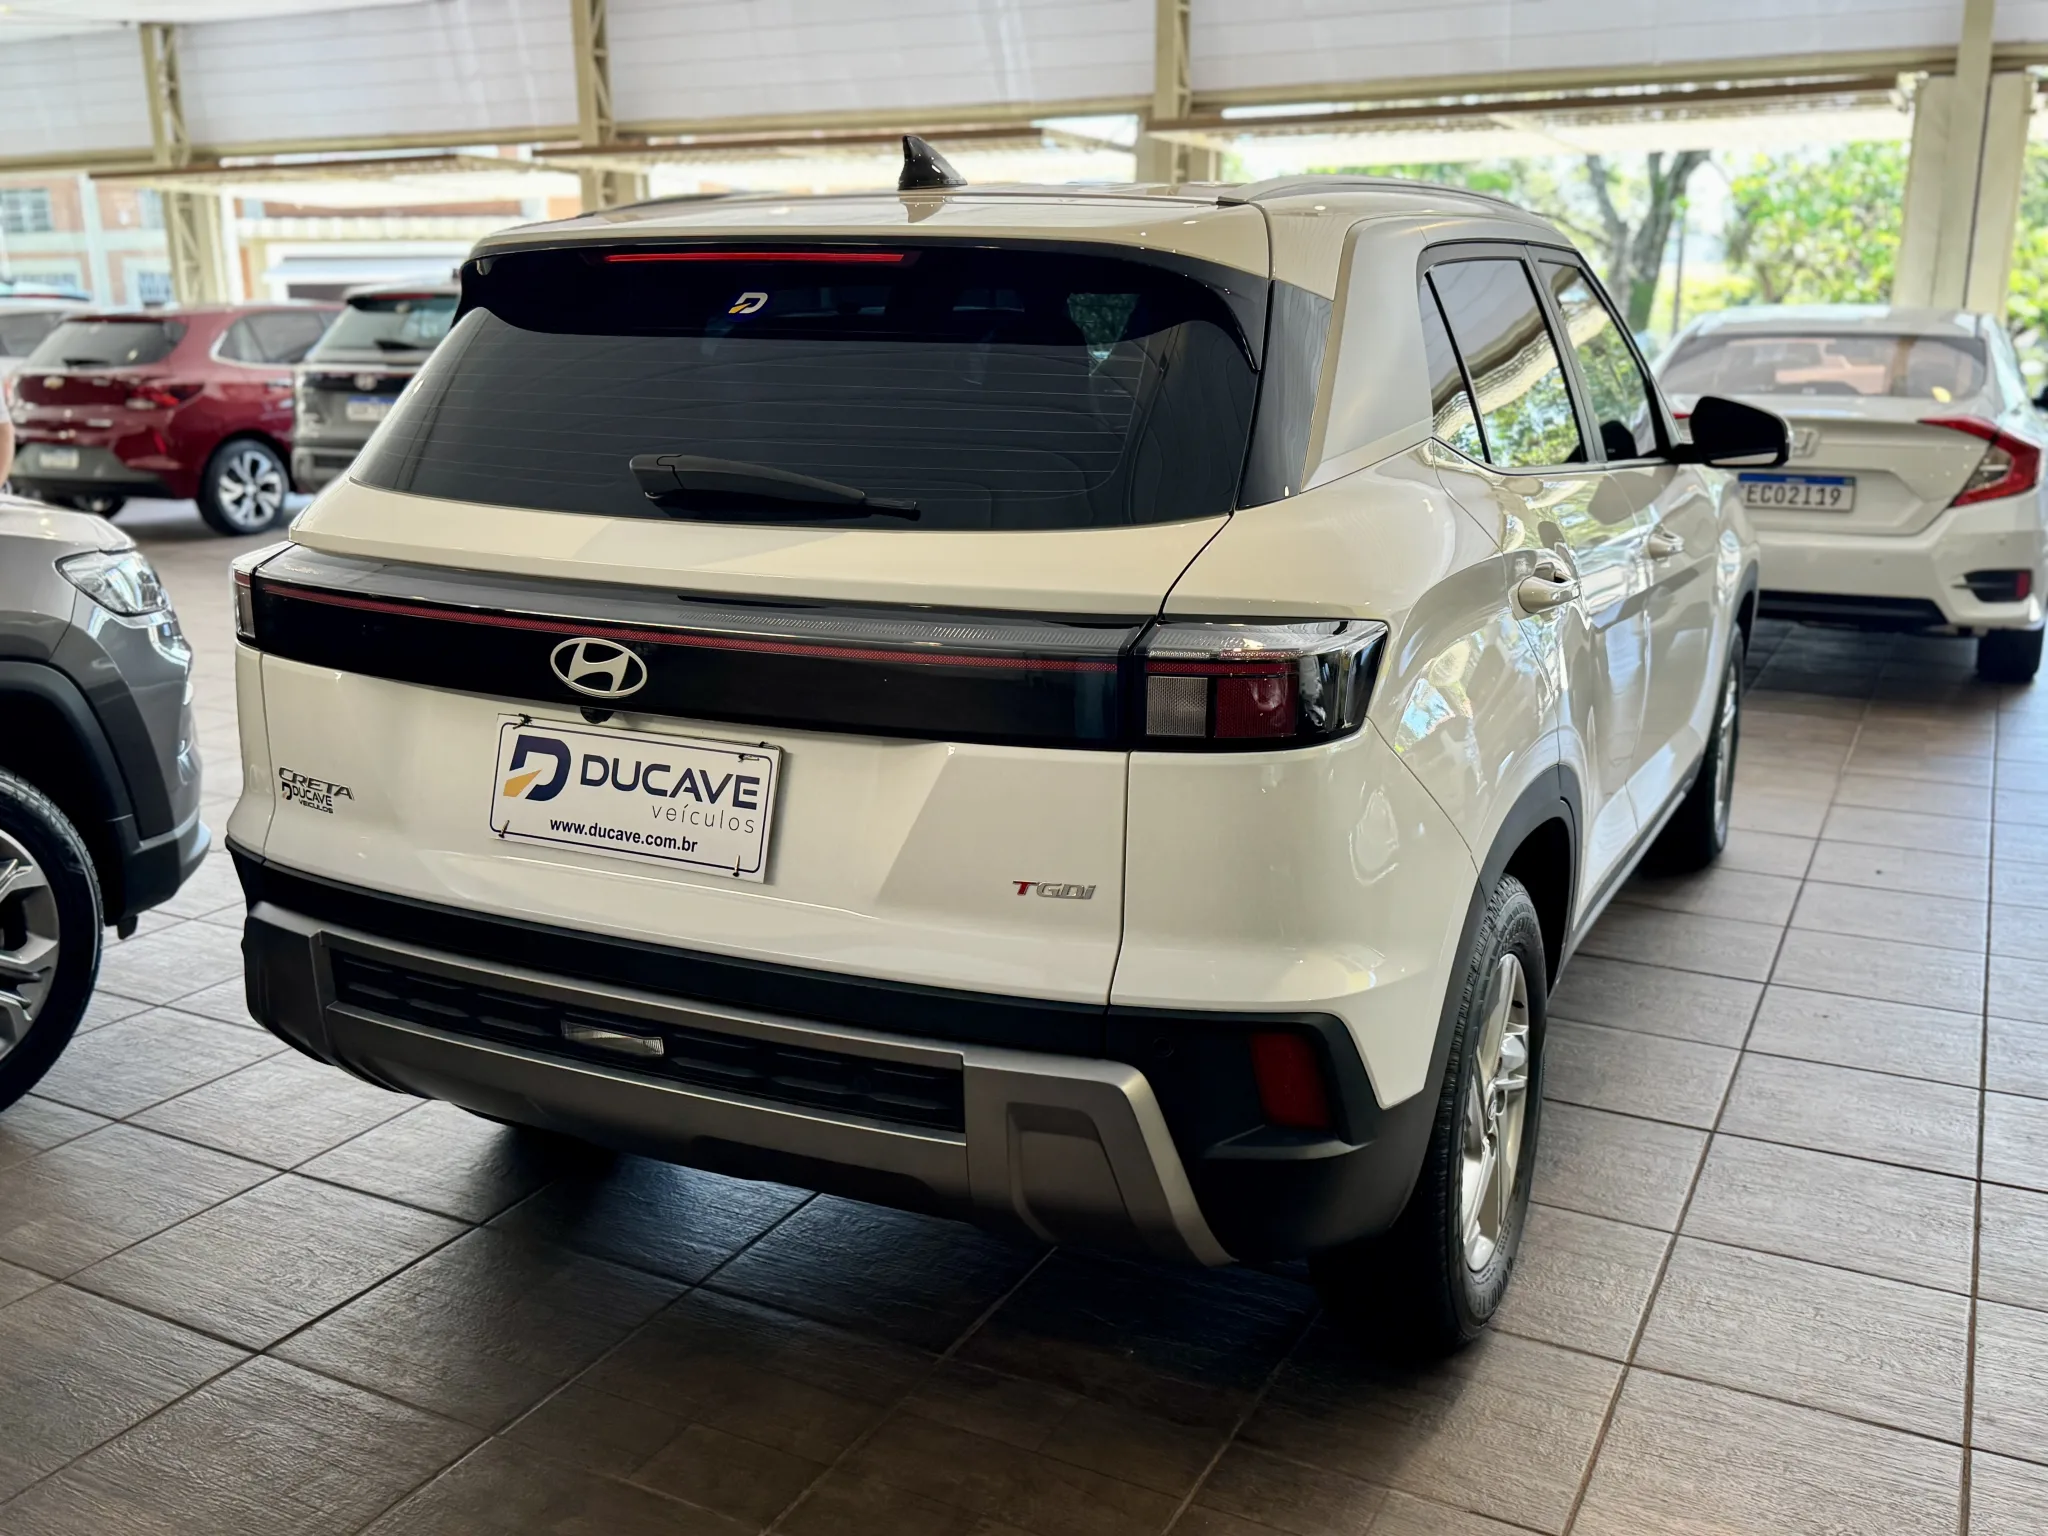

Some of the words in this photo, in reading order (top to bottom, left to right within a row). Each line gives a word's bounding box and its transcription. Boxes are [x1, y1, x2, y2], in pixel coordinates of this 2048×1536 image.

[279, 766, 355, 801] CRETA
[580, 753, 760, 810] DUCAVE
[550, 819, 698, 853] www.ducave.com.br
[651, 804, 755, 834] veículos
